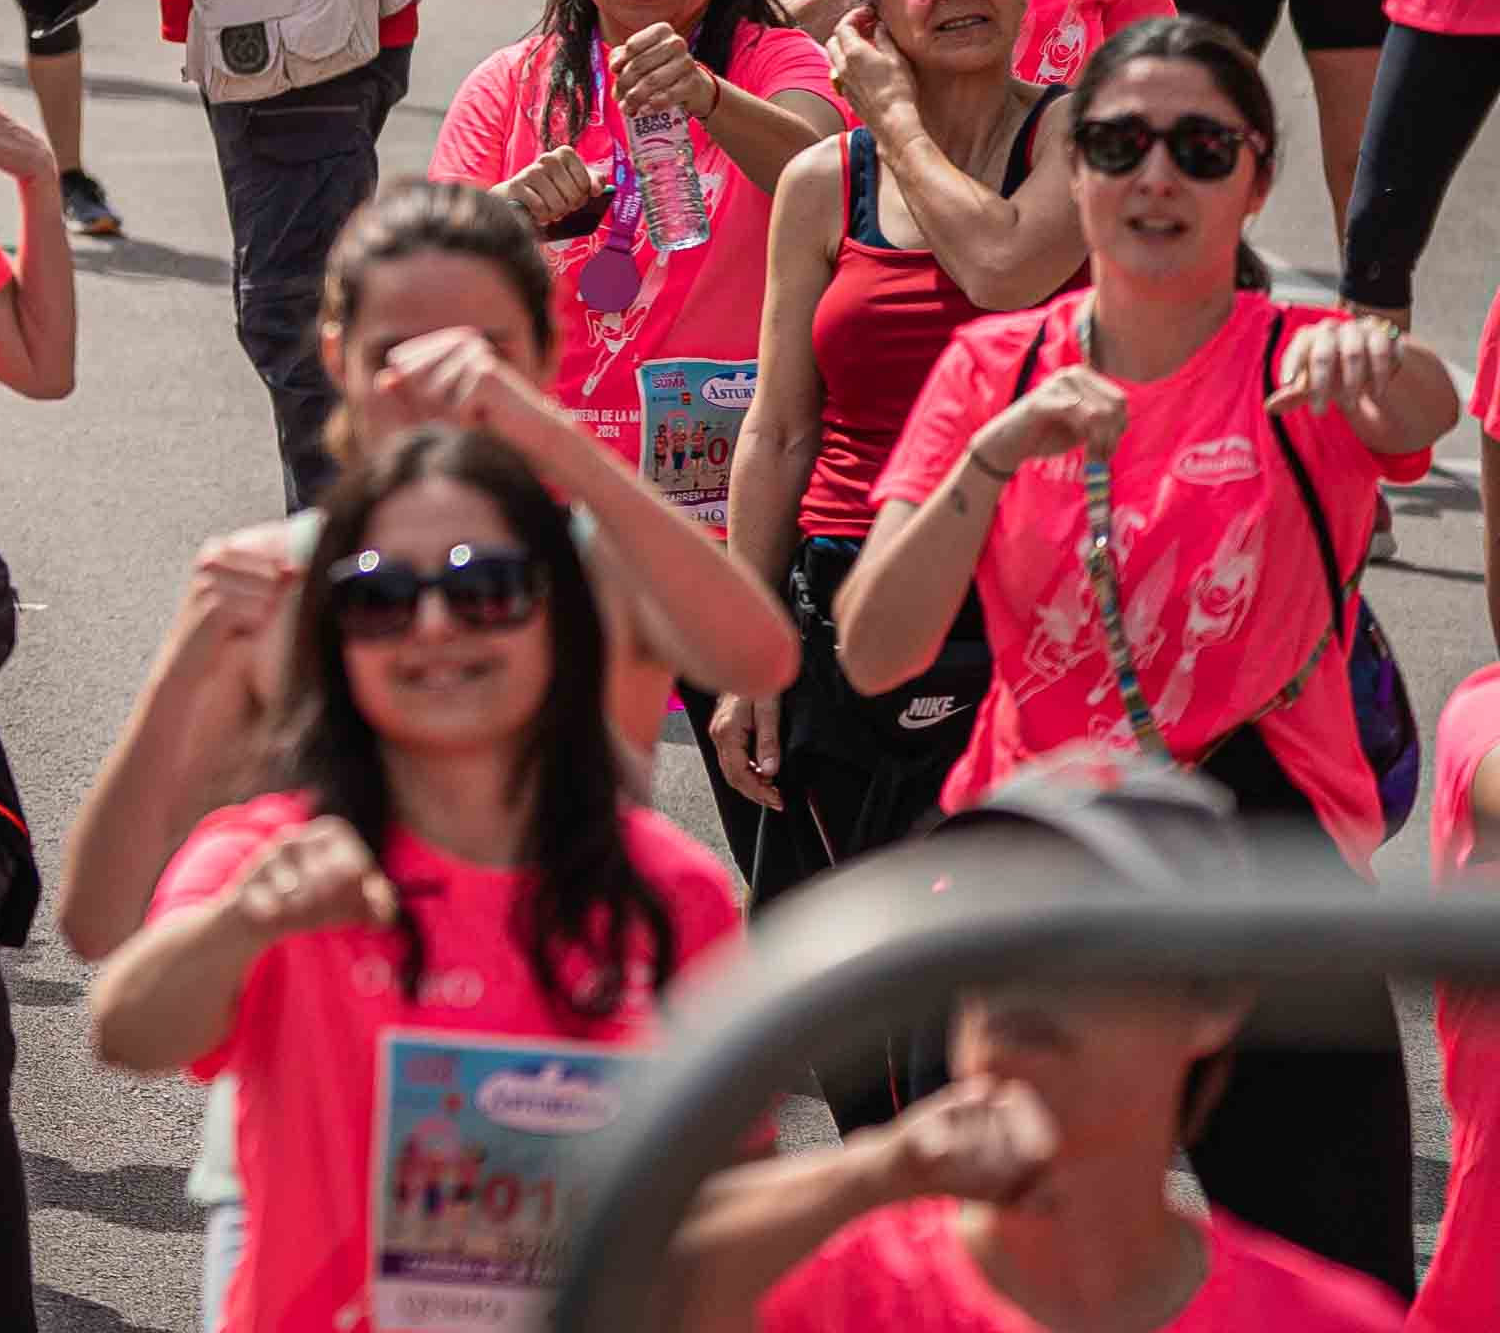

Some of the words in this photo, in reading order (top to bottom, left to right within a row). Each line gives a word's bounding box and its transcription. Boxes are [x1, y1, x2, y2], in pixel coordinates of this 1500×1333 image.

[601, 410, 614, 422] DE
[615, 410, 628, 422] LA
[596, 425, 620, 438] 2024
[908, 696, 955, 717] NIKE
